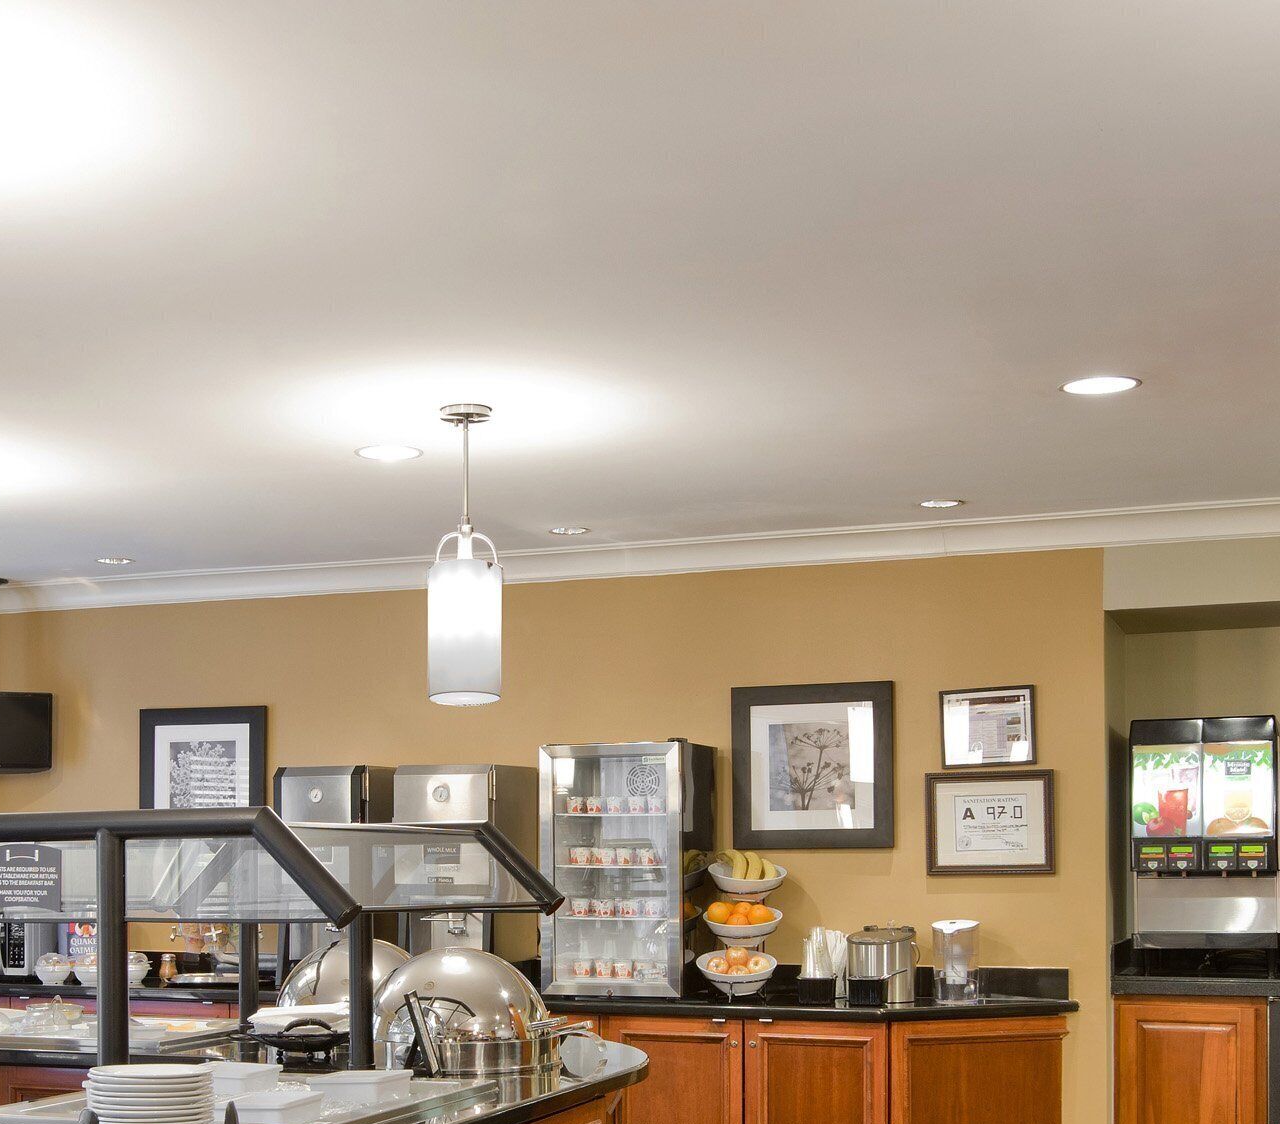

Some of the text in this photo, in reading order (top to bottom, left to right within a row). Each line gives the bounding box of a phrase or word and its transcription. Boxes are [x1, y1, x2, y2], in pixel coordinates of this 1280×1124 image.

[962, 805, 1023, 820] A 97.0
[70, 937, 97, 946] QUAKE
[69, 946, 97, 954] OATME
